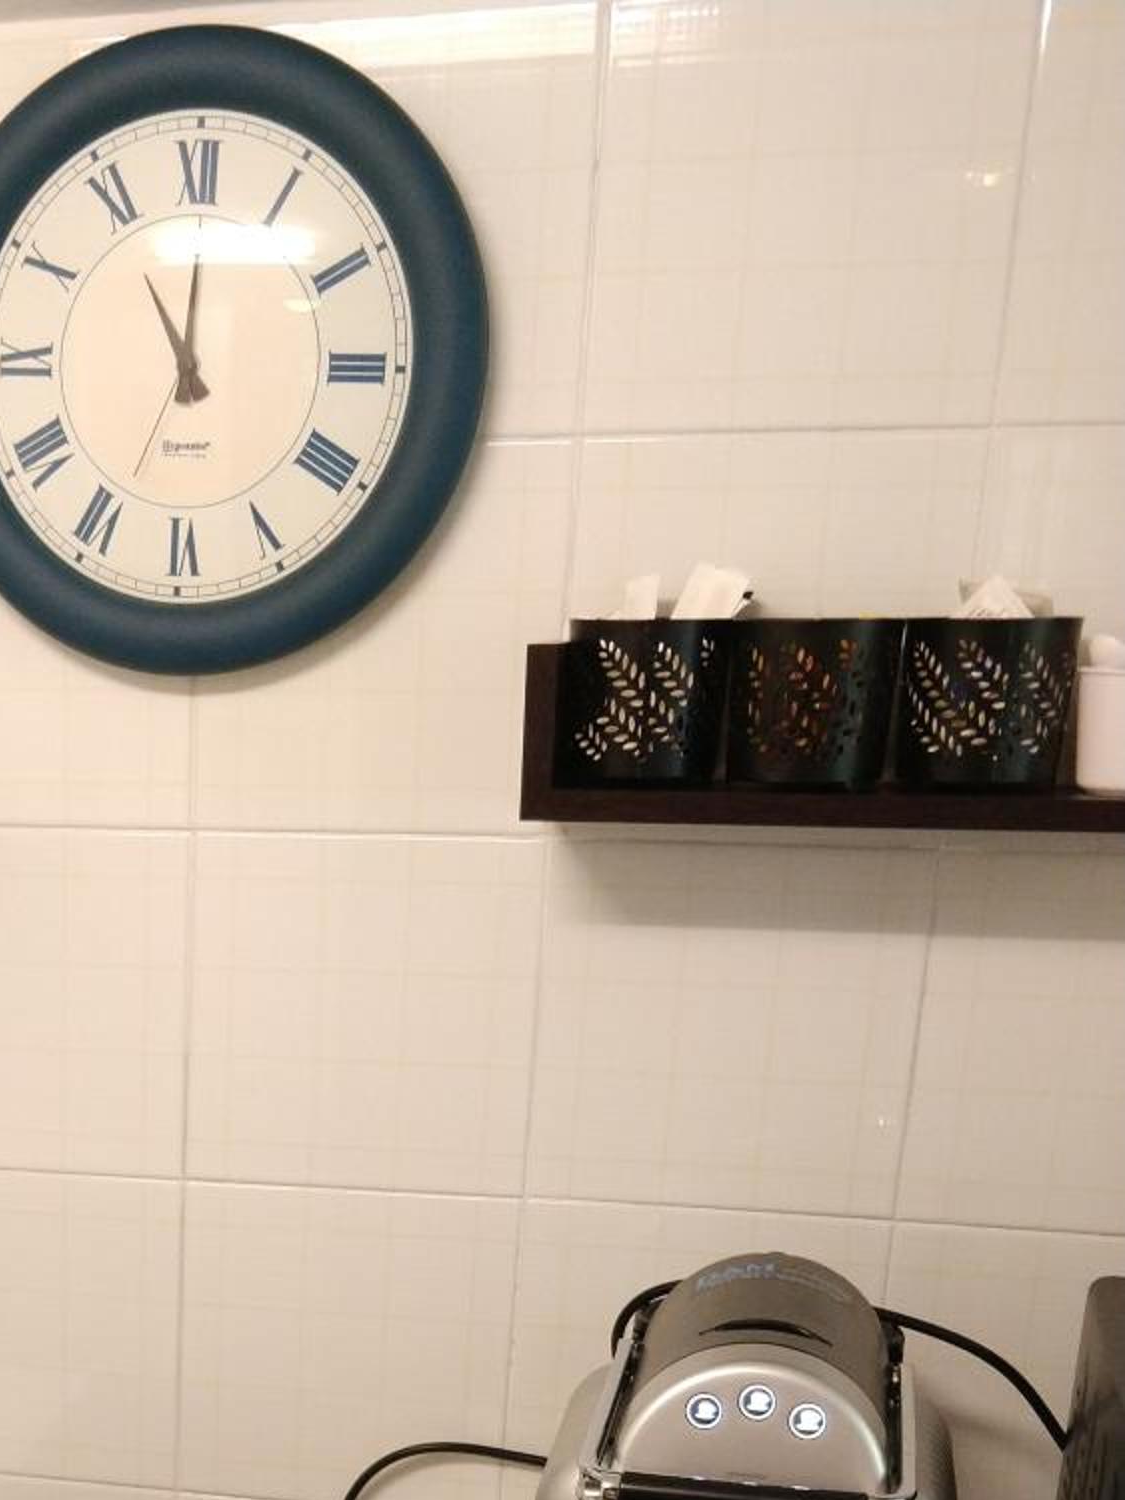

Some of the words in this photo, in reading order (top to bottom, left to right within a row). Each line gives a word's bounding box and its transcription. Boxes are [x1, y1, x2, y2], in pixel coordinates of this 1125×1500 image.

[87, 160, 144, 235] XI
[177, 140, 220, 207] XII
[262, 167, 304, 227] I
[23, 241, 77, 292] X
[312, 246, 371, 295] II
[0, 338, 53, 378] IX
[328, 351, 388, 386] III
[13, 417, 74, 492] VIII
[294, 428, 361, 495] IIII
[73, 484, 124, 557] VII
[166, 517, 202, 577] VI
[249, 501, 284, 560] V
